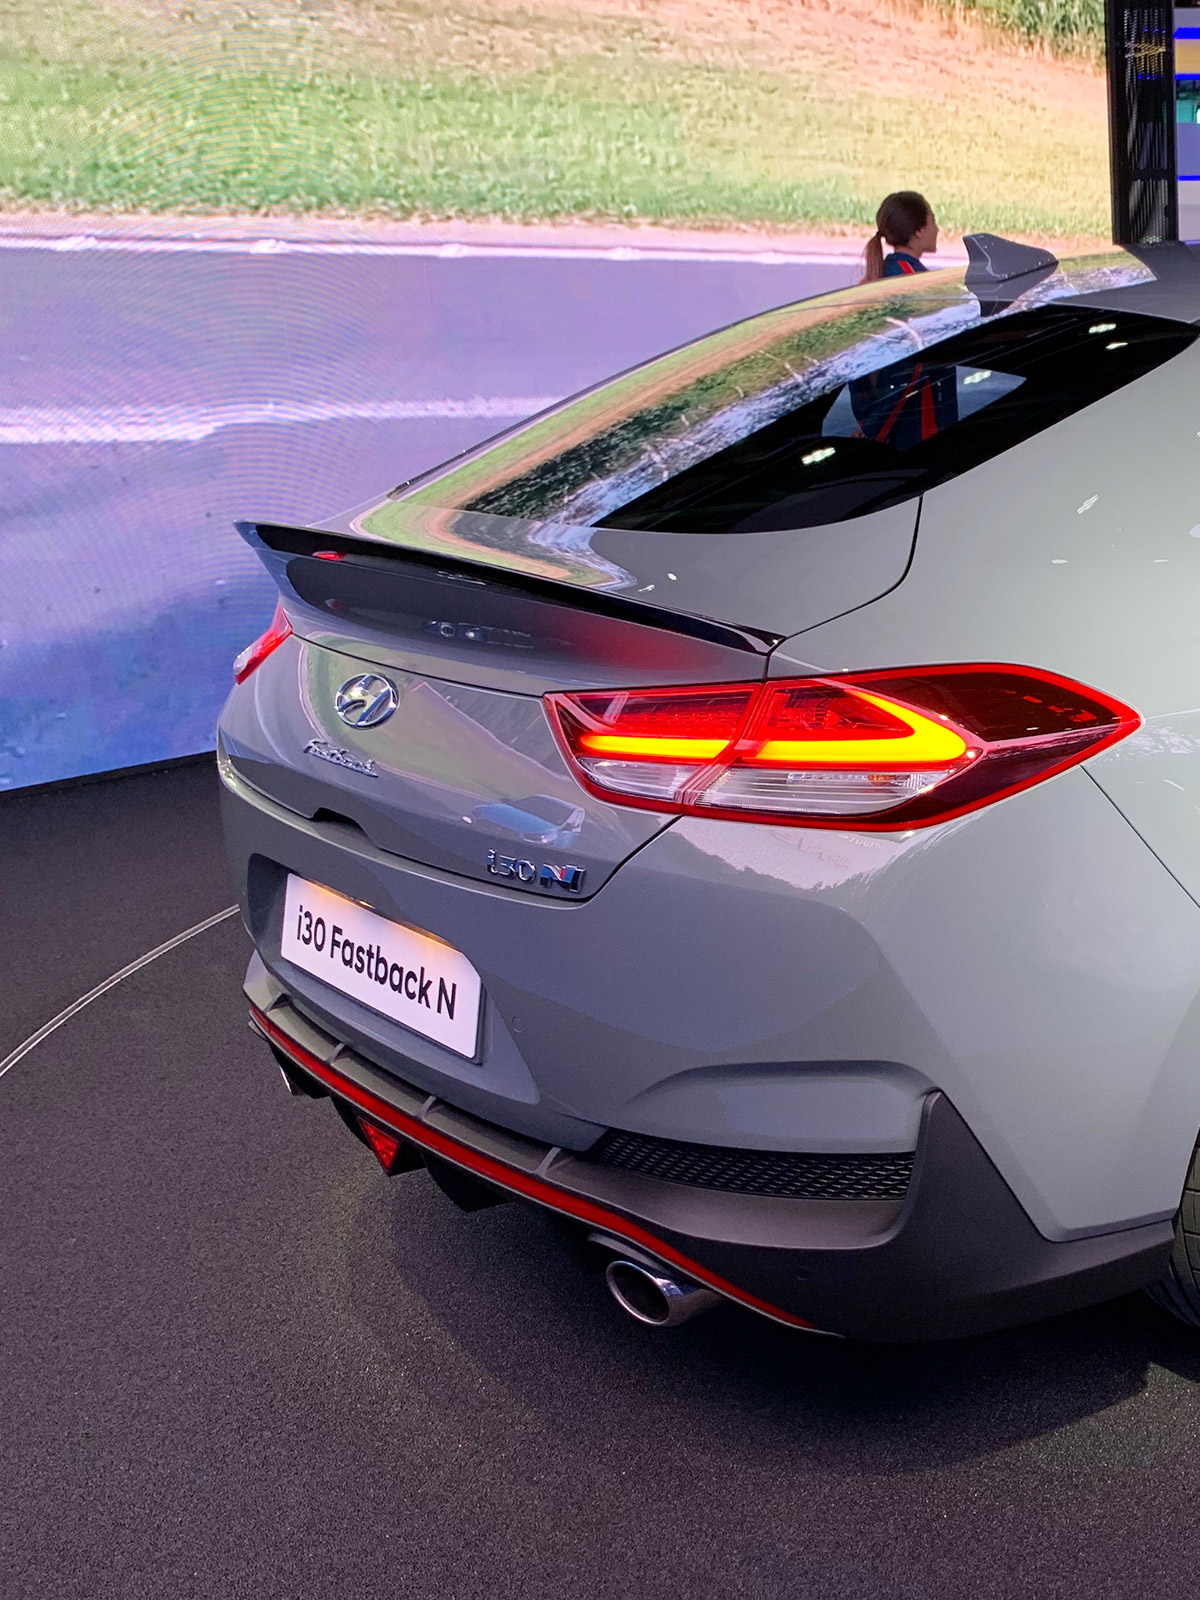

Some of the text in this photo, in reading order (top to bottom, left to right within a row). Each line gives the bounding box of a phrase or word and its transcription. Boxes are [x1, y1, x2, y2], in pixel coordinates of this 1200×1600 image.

[487, 848, 585, 893] i30 N
[296, 904, 457, 1021] i30 Fastback N
